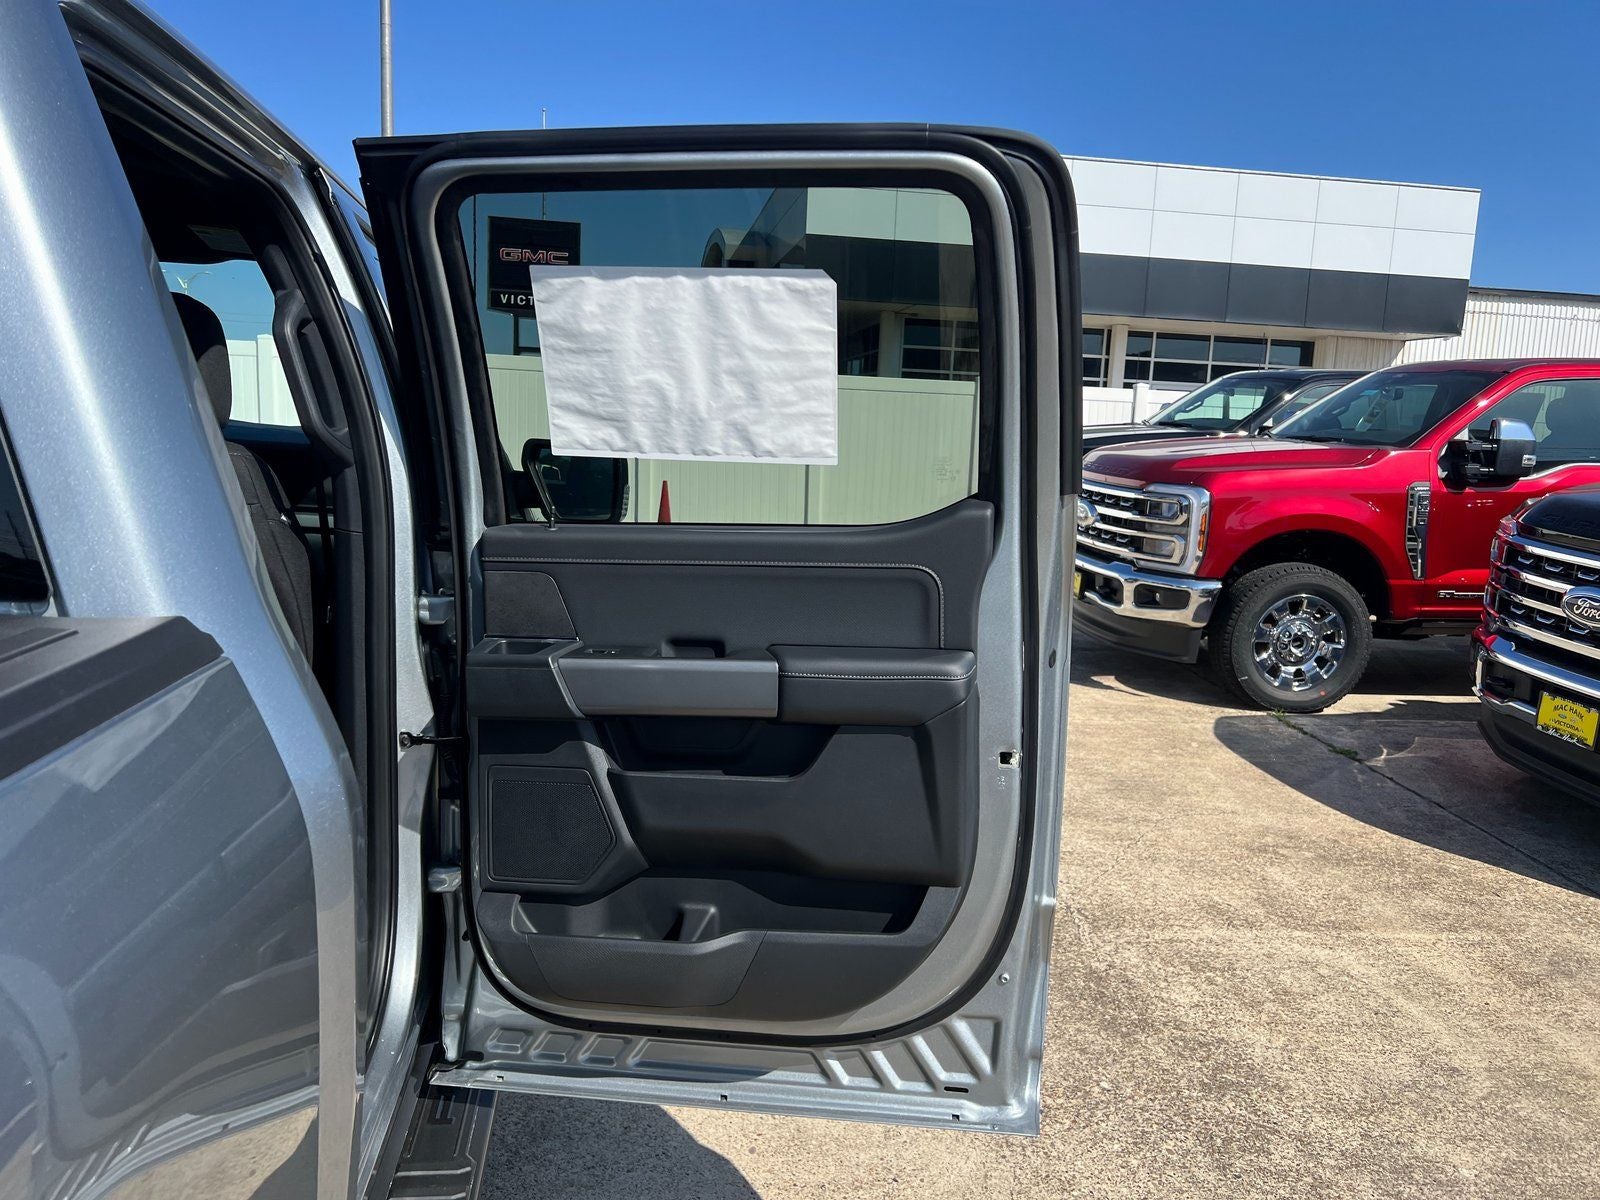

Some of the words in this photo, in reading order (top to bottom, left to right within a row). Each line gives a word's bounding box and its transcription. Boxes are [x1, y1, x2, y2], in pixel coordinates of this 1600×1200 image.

[500, 247, 569, 265] GMC
[500, 293, 535, 306] VICT
[1552, 704, 1569, 712] MAC
